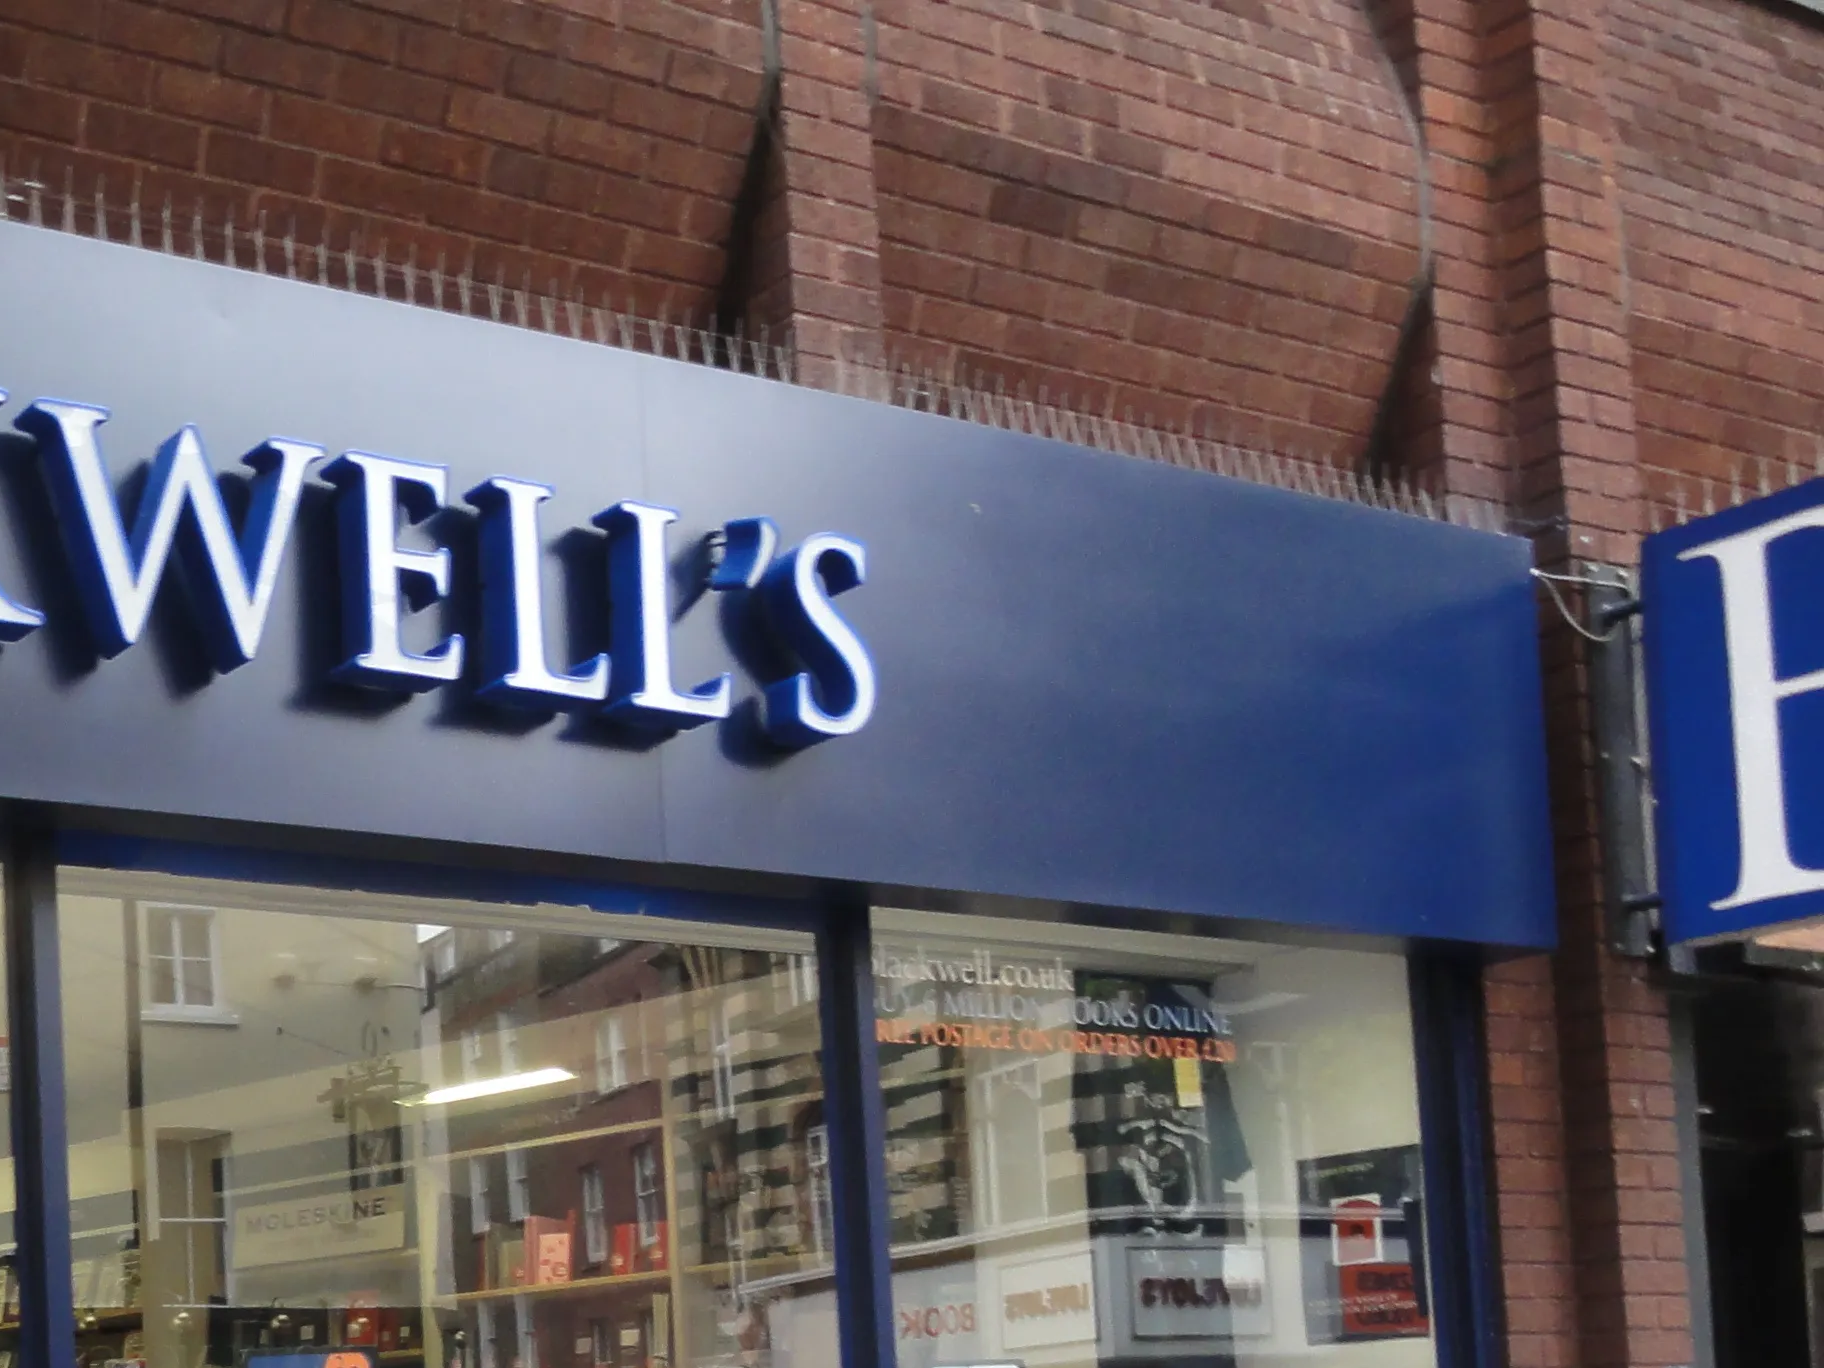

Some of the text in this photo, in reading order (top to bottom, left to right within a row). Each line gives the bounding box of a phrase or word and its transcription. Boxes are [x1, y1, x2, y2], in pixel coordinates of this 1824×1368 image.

[876, 991, 908, 1013] UY
[1143, 1003, 1233, 1036] ONLINE
[876, 1018, 916, 1044] REE
[920, 1021, 1014, 1050] POSTAGE
[1017, 1027, 1054, 1053] ON
[1060, 1030, 1144, 1057] ORDERS
[1143, 1035, 1200, 1061] OVER
